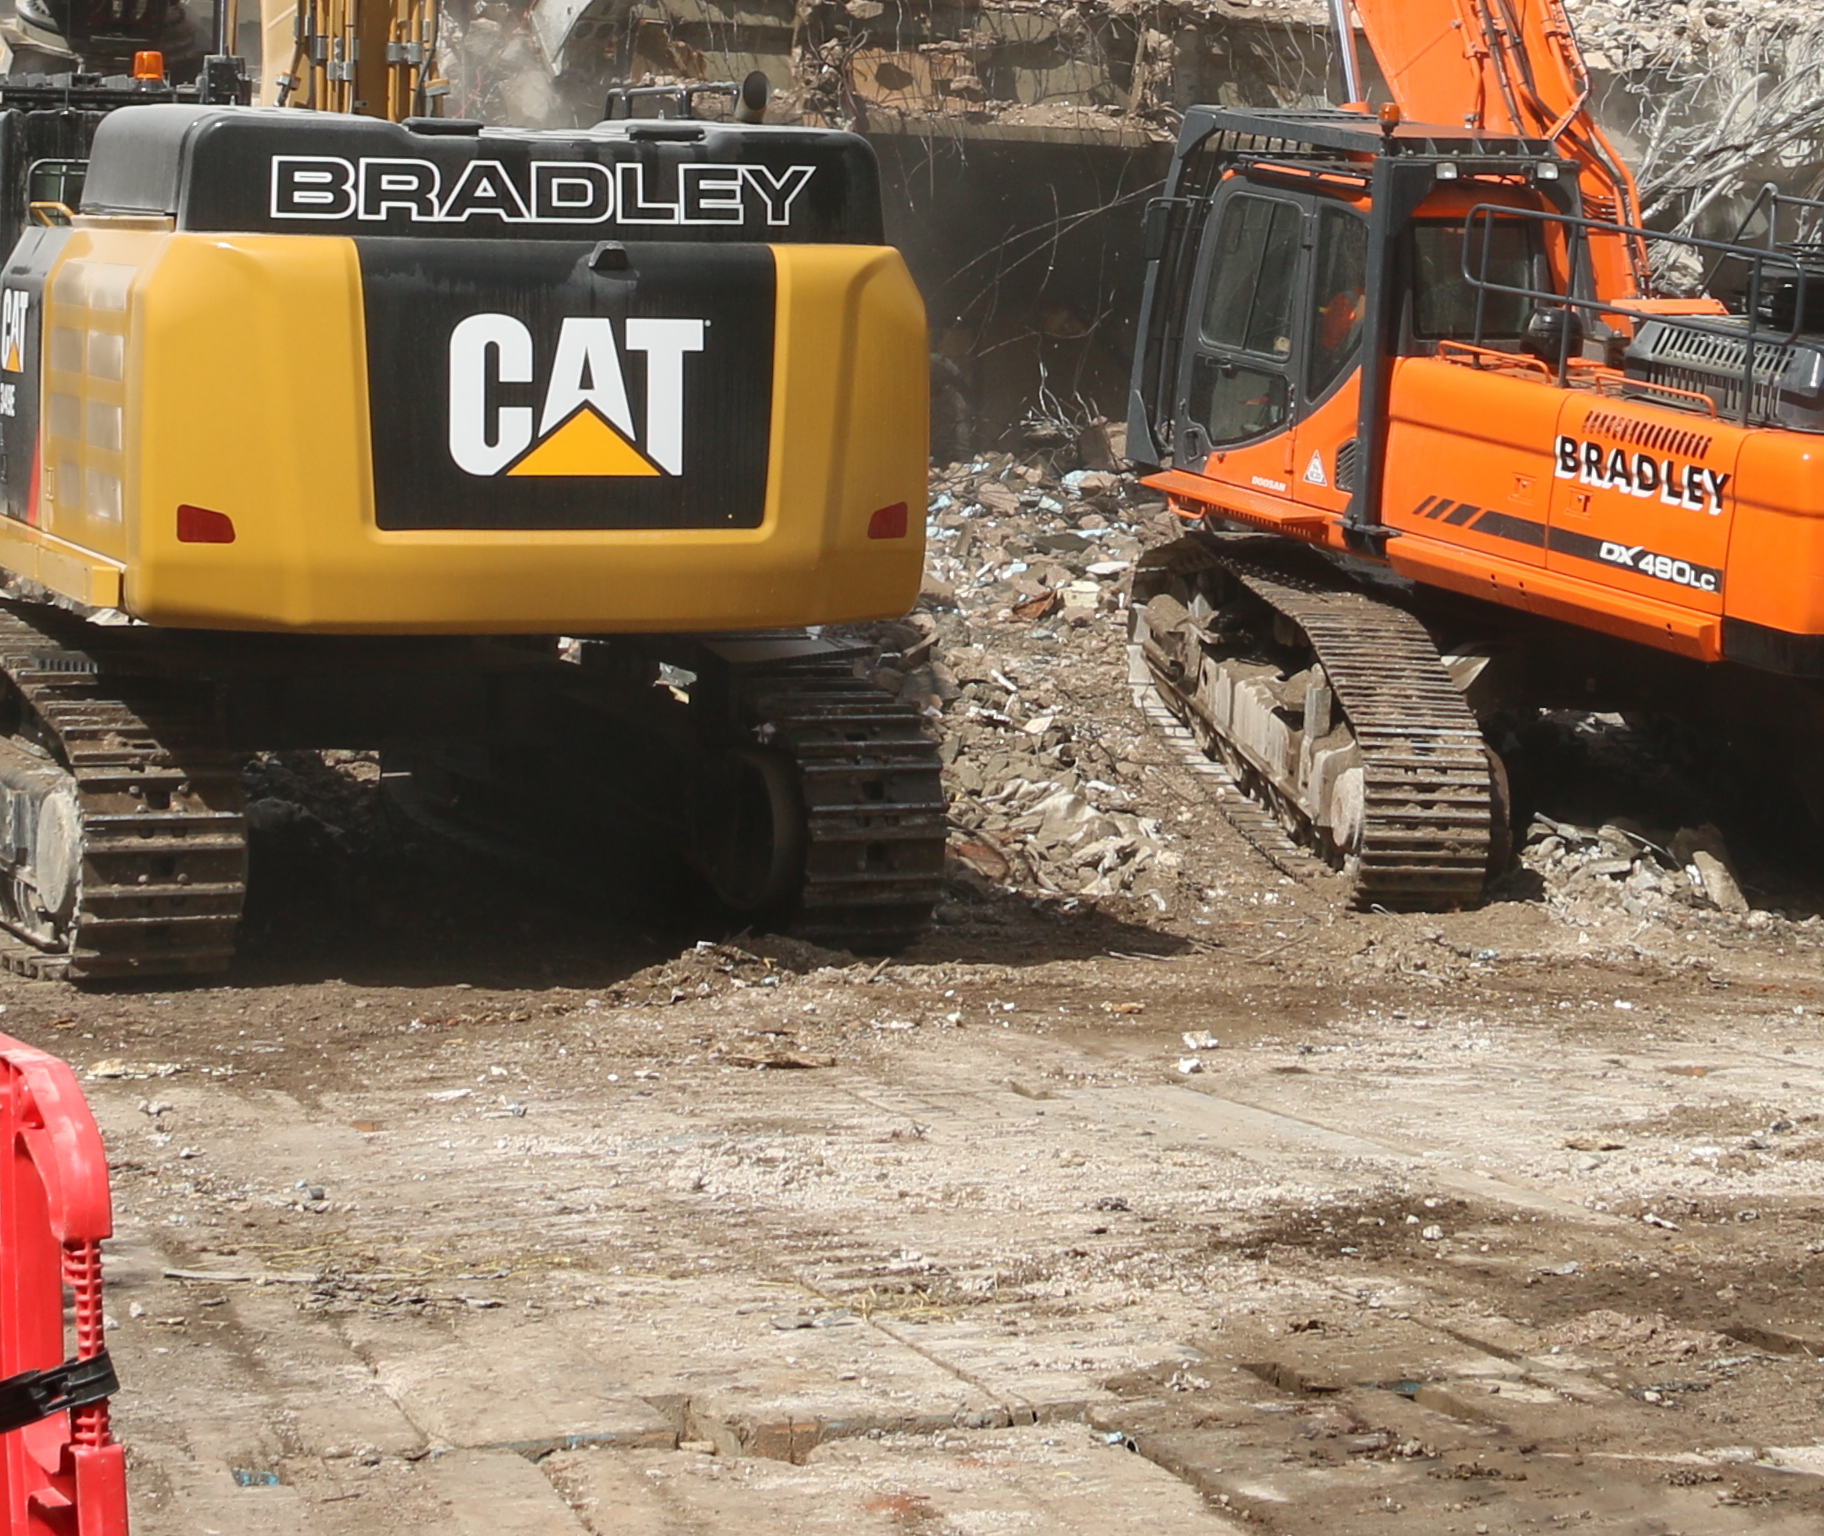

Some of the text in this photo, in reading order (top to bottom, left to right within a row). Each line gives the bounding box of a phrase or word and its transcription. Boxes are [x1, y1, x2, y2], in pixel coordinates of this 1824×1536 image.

[270, 155, 817, 227] BRADLEY
[1, 288, 29, 373] CAT
[448, 312, 705, 477] CAT
[1251, 475, 1287, 493] DOOSAN
[1554, 434, 1732, 516] BRADLEY
